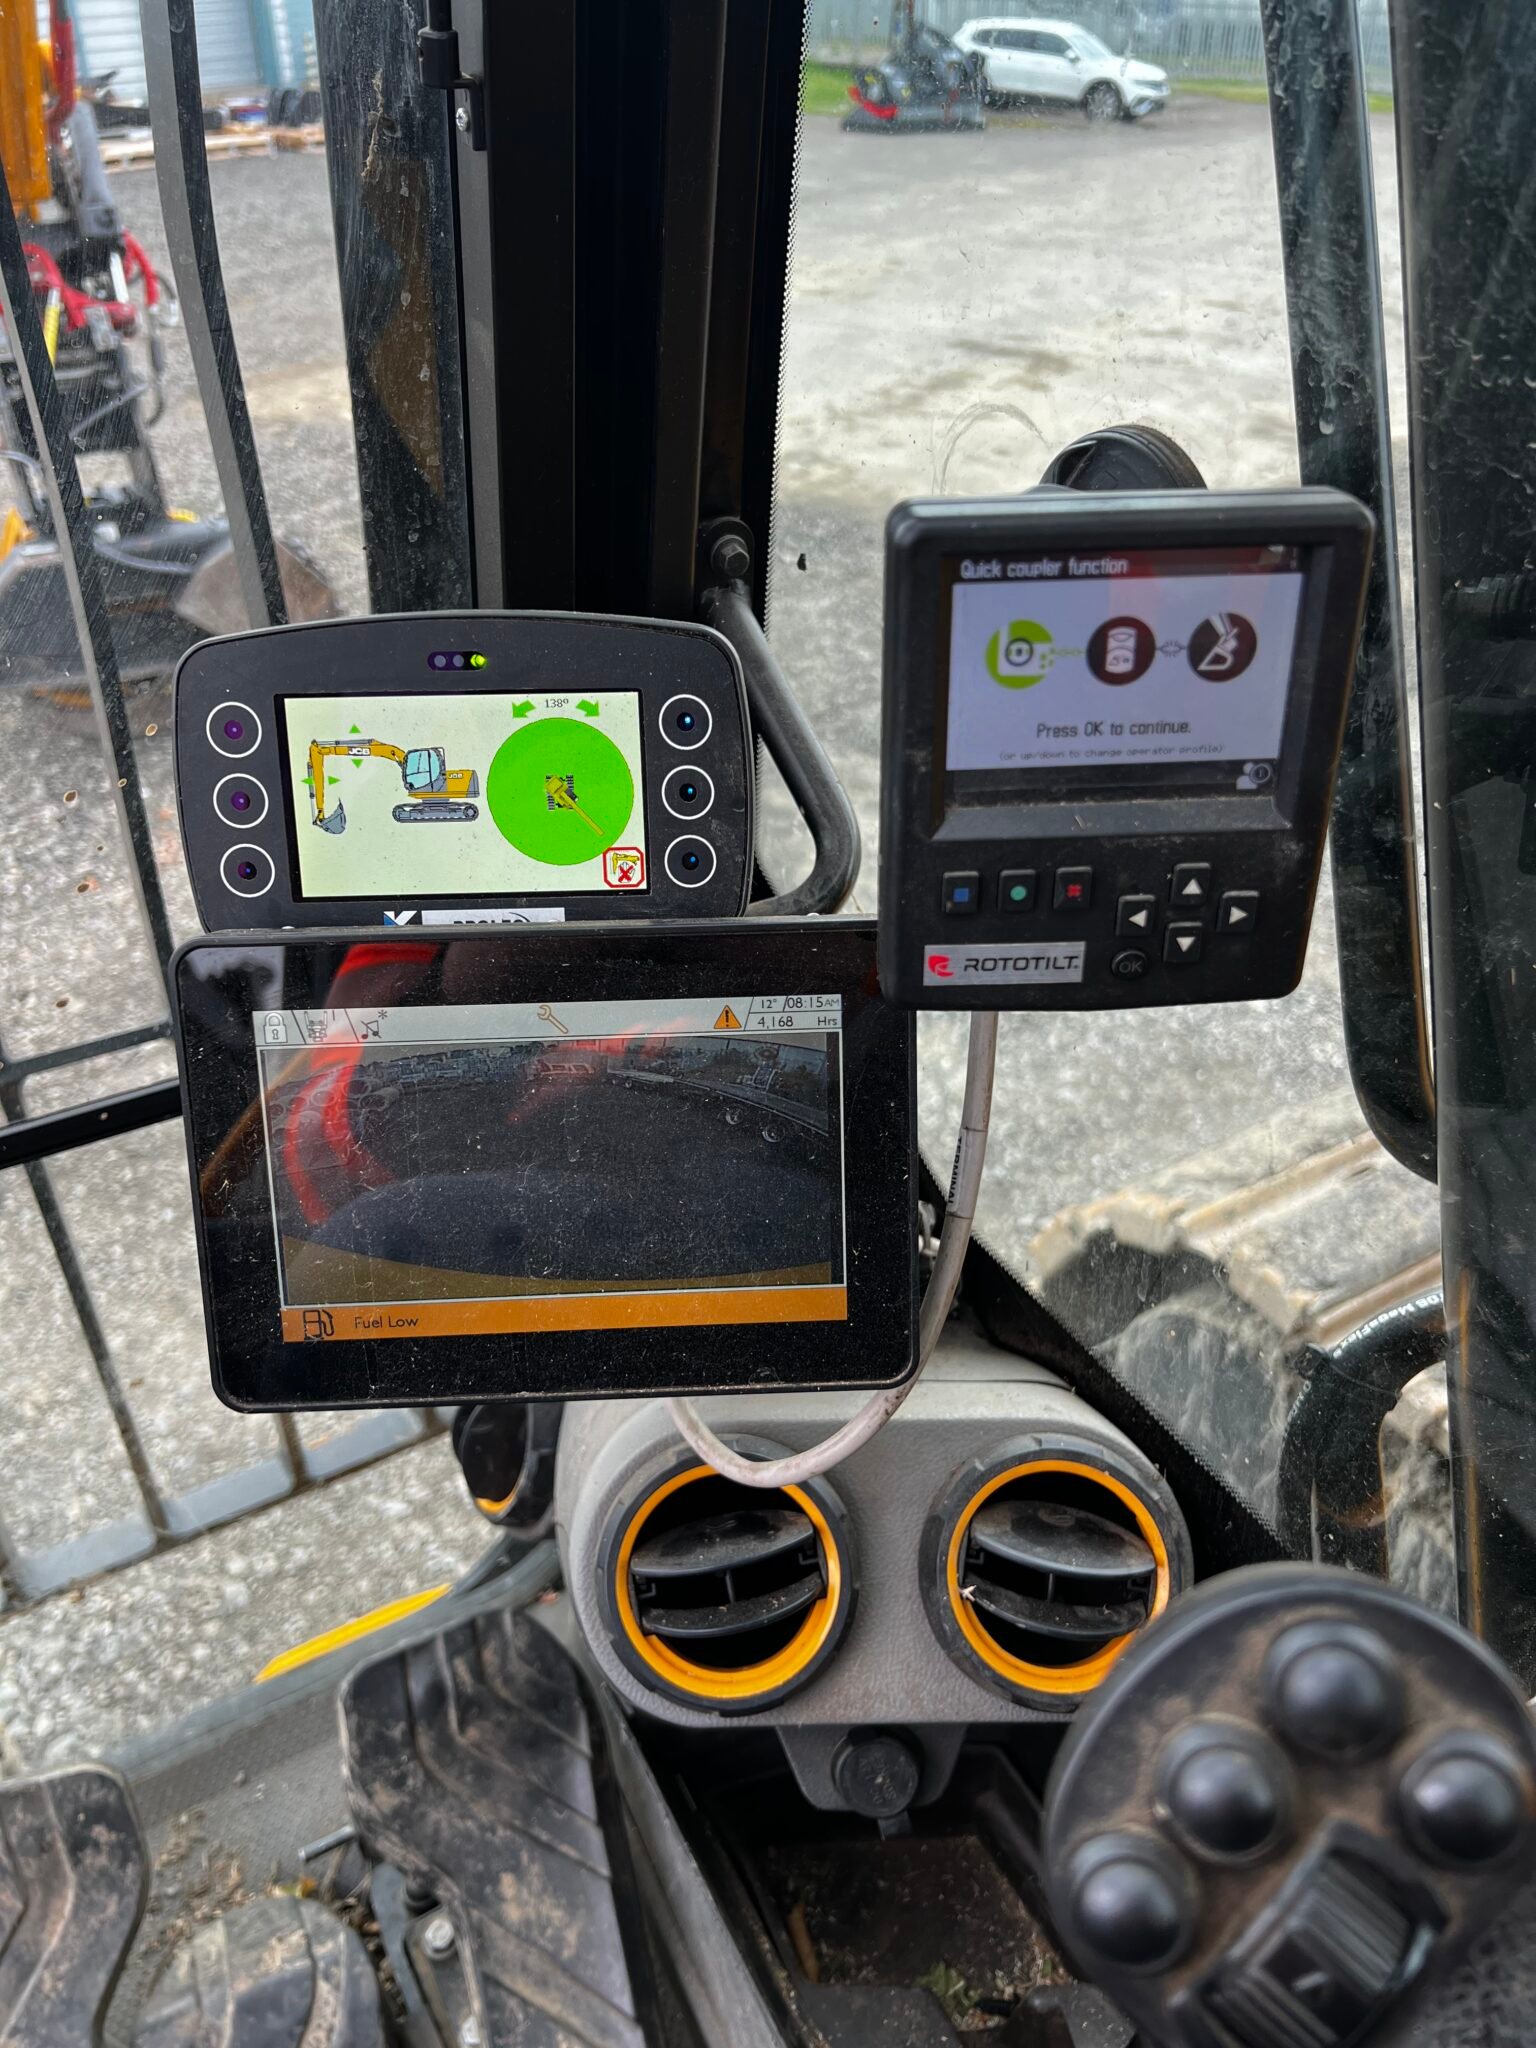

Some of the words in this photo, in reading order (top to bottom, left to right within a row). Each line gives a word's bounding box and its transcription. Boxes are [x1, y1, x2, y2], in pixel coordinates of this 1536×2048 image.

[960, 558, 1001, 579] Quick
[1007, 556, 1062, 579] coupler
[1068, 555, 1128, 576] function
[1036, 722, 1078, 738] Press
[1084, 721, 1104, 737] OK
[1110, 722, 1123, 736] to
[1129, 720, 1192, 736] continue.
[348, 747, 370, 756] JCB
[1069, 749, 1081, 759] to
[1084, 748, 1122, 759] change
[1126, 747, 1175, 758] operator
[1119, 960, 1143, 974] OK
[817, 1016, 838, 1026] Hrs
[354, 1316, 383, 1329] Fuel
[388, 1315, 419, 1328] Low
